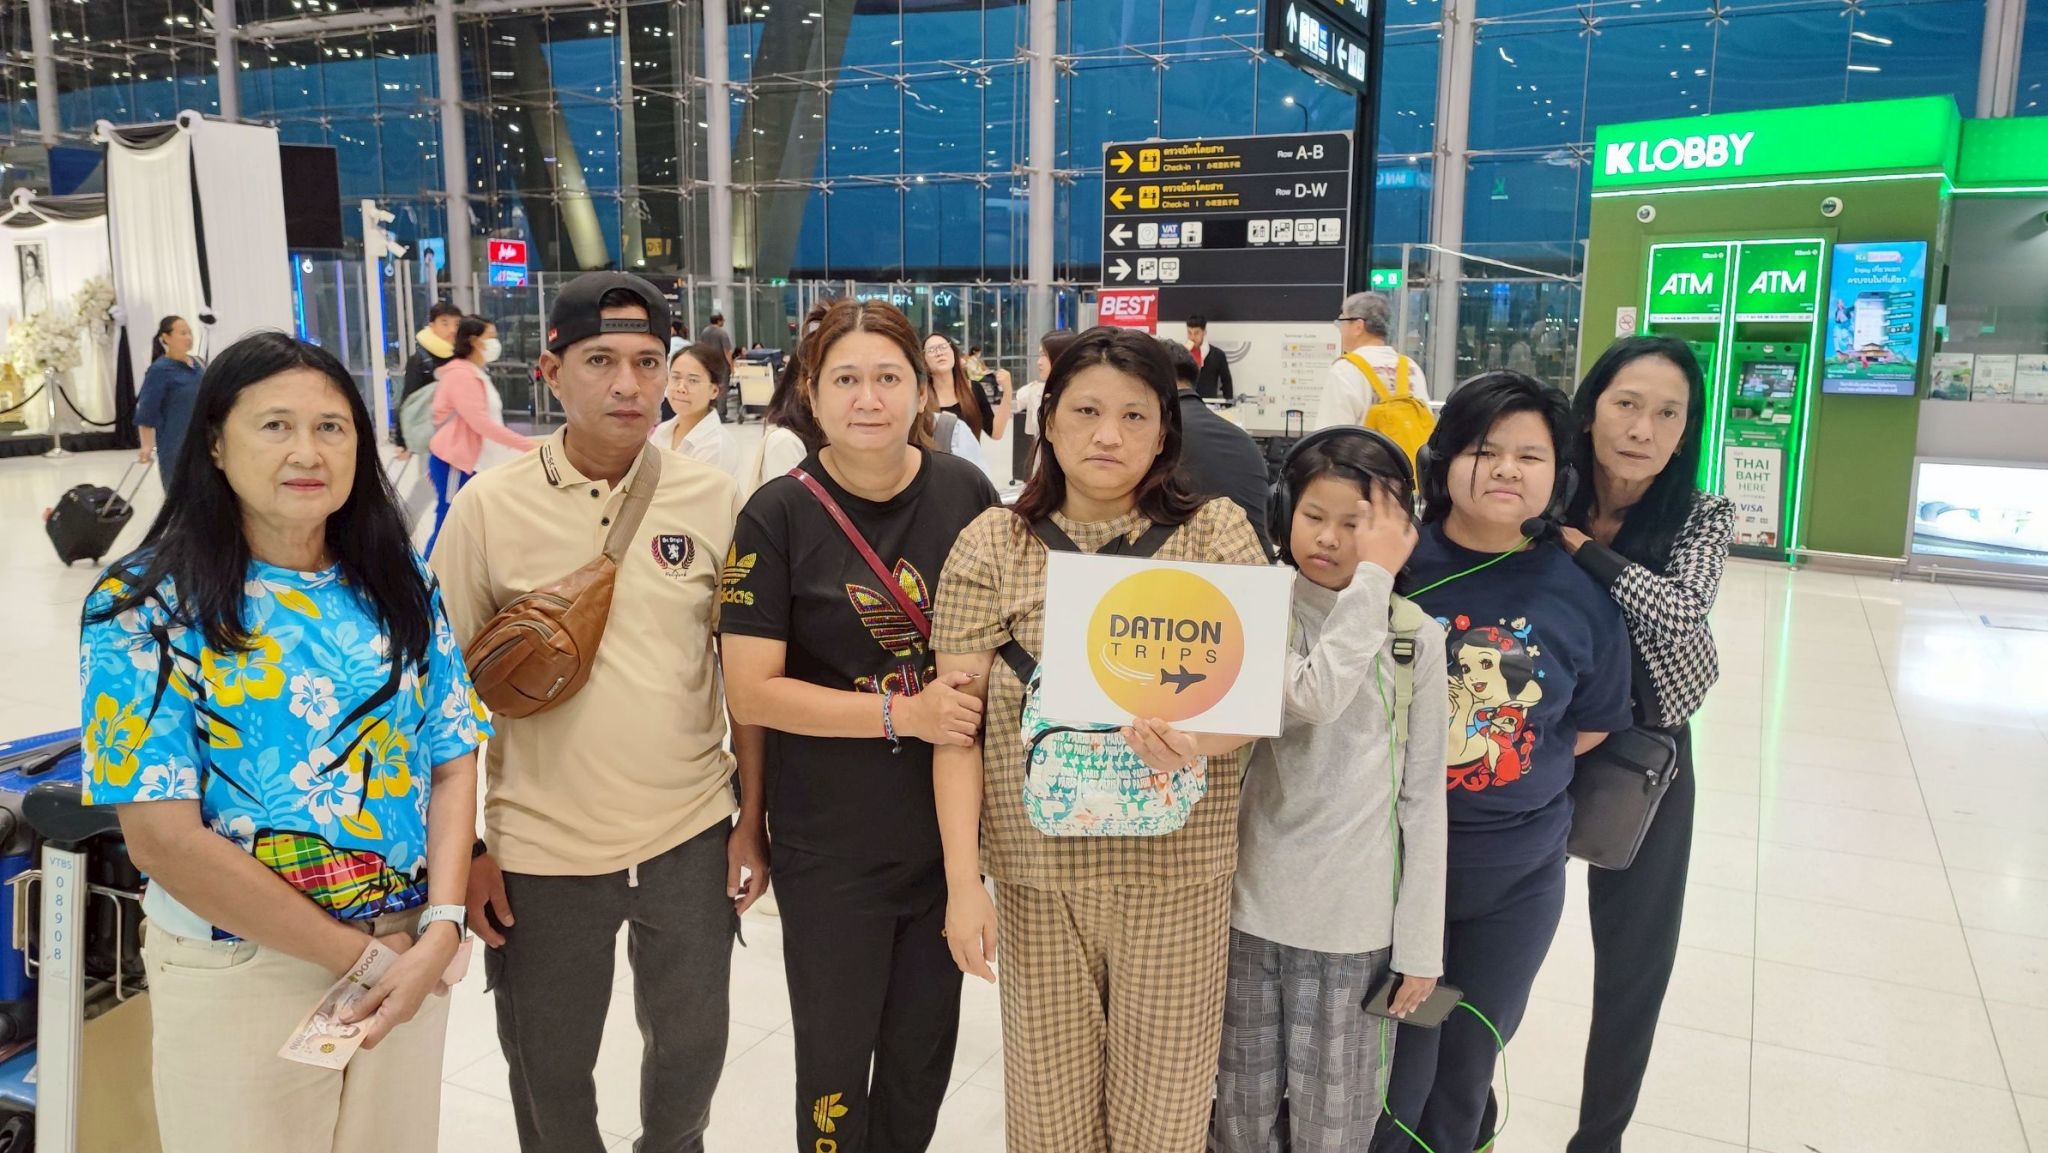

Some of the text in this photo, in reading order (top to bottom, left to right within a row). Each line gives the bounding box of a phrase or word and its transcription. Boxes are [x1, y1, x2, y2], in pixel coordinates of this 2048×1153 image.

[1277, 144, 1324, 160] Row A-B
[1163, 162, 1191, 172] Check-in
[1275, 182, 1328, 198] Row D-W
[1162, 200, 1190, 209] Check-in
[1161, 224, 1178, 233] VAT
[1659, 271, 1714, 296] ATM
[1747, 270, 1807, 294] ATM
[1100, 295, 1155, 315] BEST
[1733, 458, 1769, 470] THAI
[1735, 470, 1771, 482] BAHT
[1738, 482, 1766, 492] HERE
[1740, 503, 1763, 512] VISA
[1109, 613, 1222, 645] DATION
[1110, 642, 1217, 664] TRIPS
